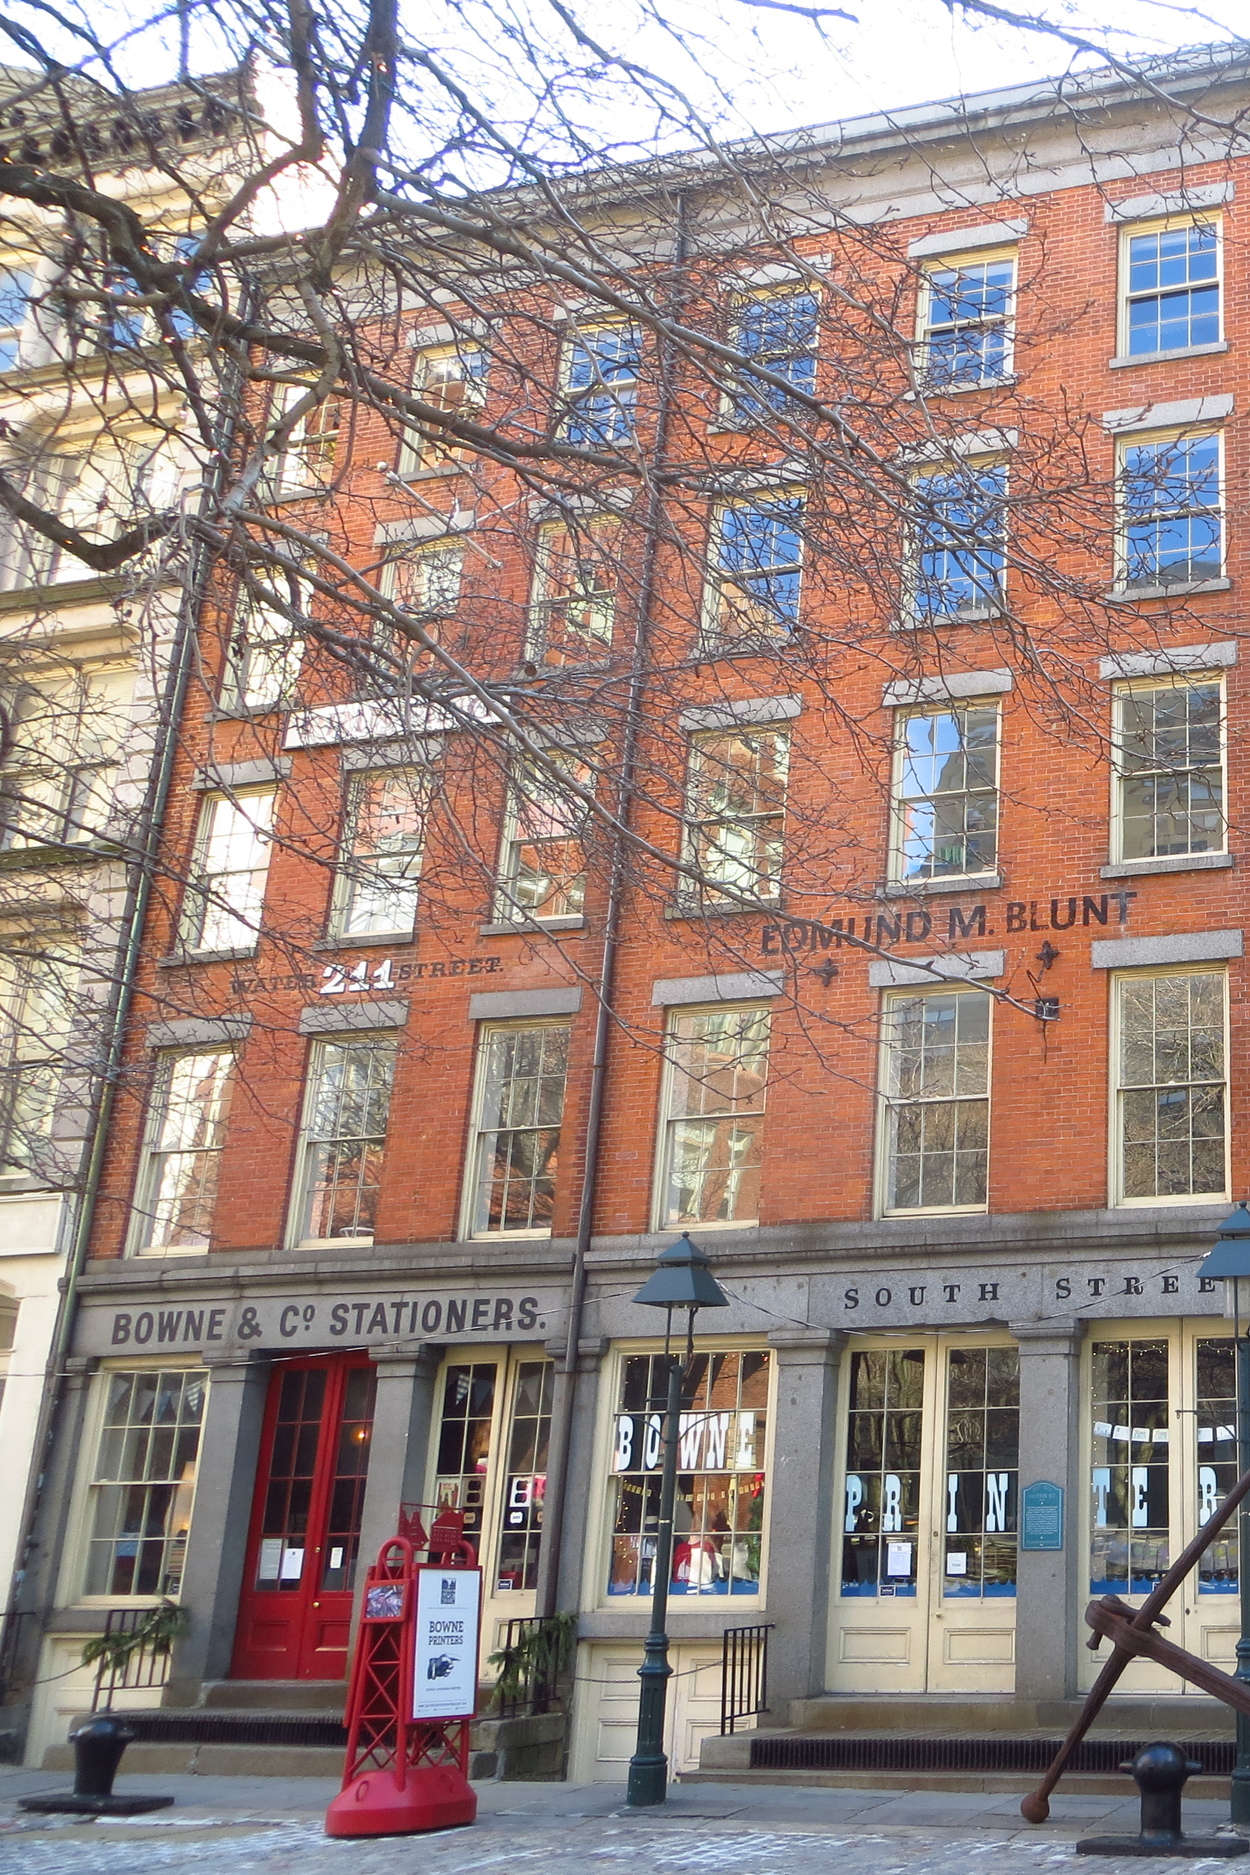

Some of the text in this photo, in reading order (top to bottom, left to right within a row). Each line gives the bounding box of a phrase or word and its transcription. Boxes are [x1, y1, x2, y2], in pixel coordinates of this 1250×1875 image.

[761, 892, 1138, 956] EDMUND M. BLUNT
[230, 974, 316, 996] WATER
[319, 959, 396, 996] 211
[844, 1283, 1000, 1310] SOUTH
[1055, 1275, 1216, 1300] STREE
[111, 1308, 228, 1346] BOWNE
[237, 1306, 261, 1341] &
[329, 1296, 548, 1337] STATIONERS.
[618, 1412, 755, 1471] BOWNE
[428, 1635, 464, 1646] PRINTERS
[429, 1620, 464, 1634] BOWNE
